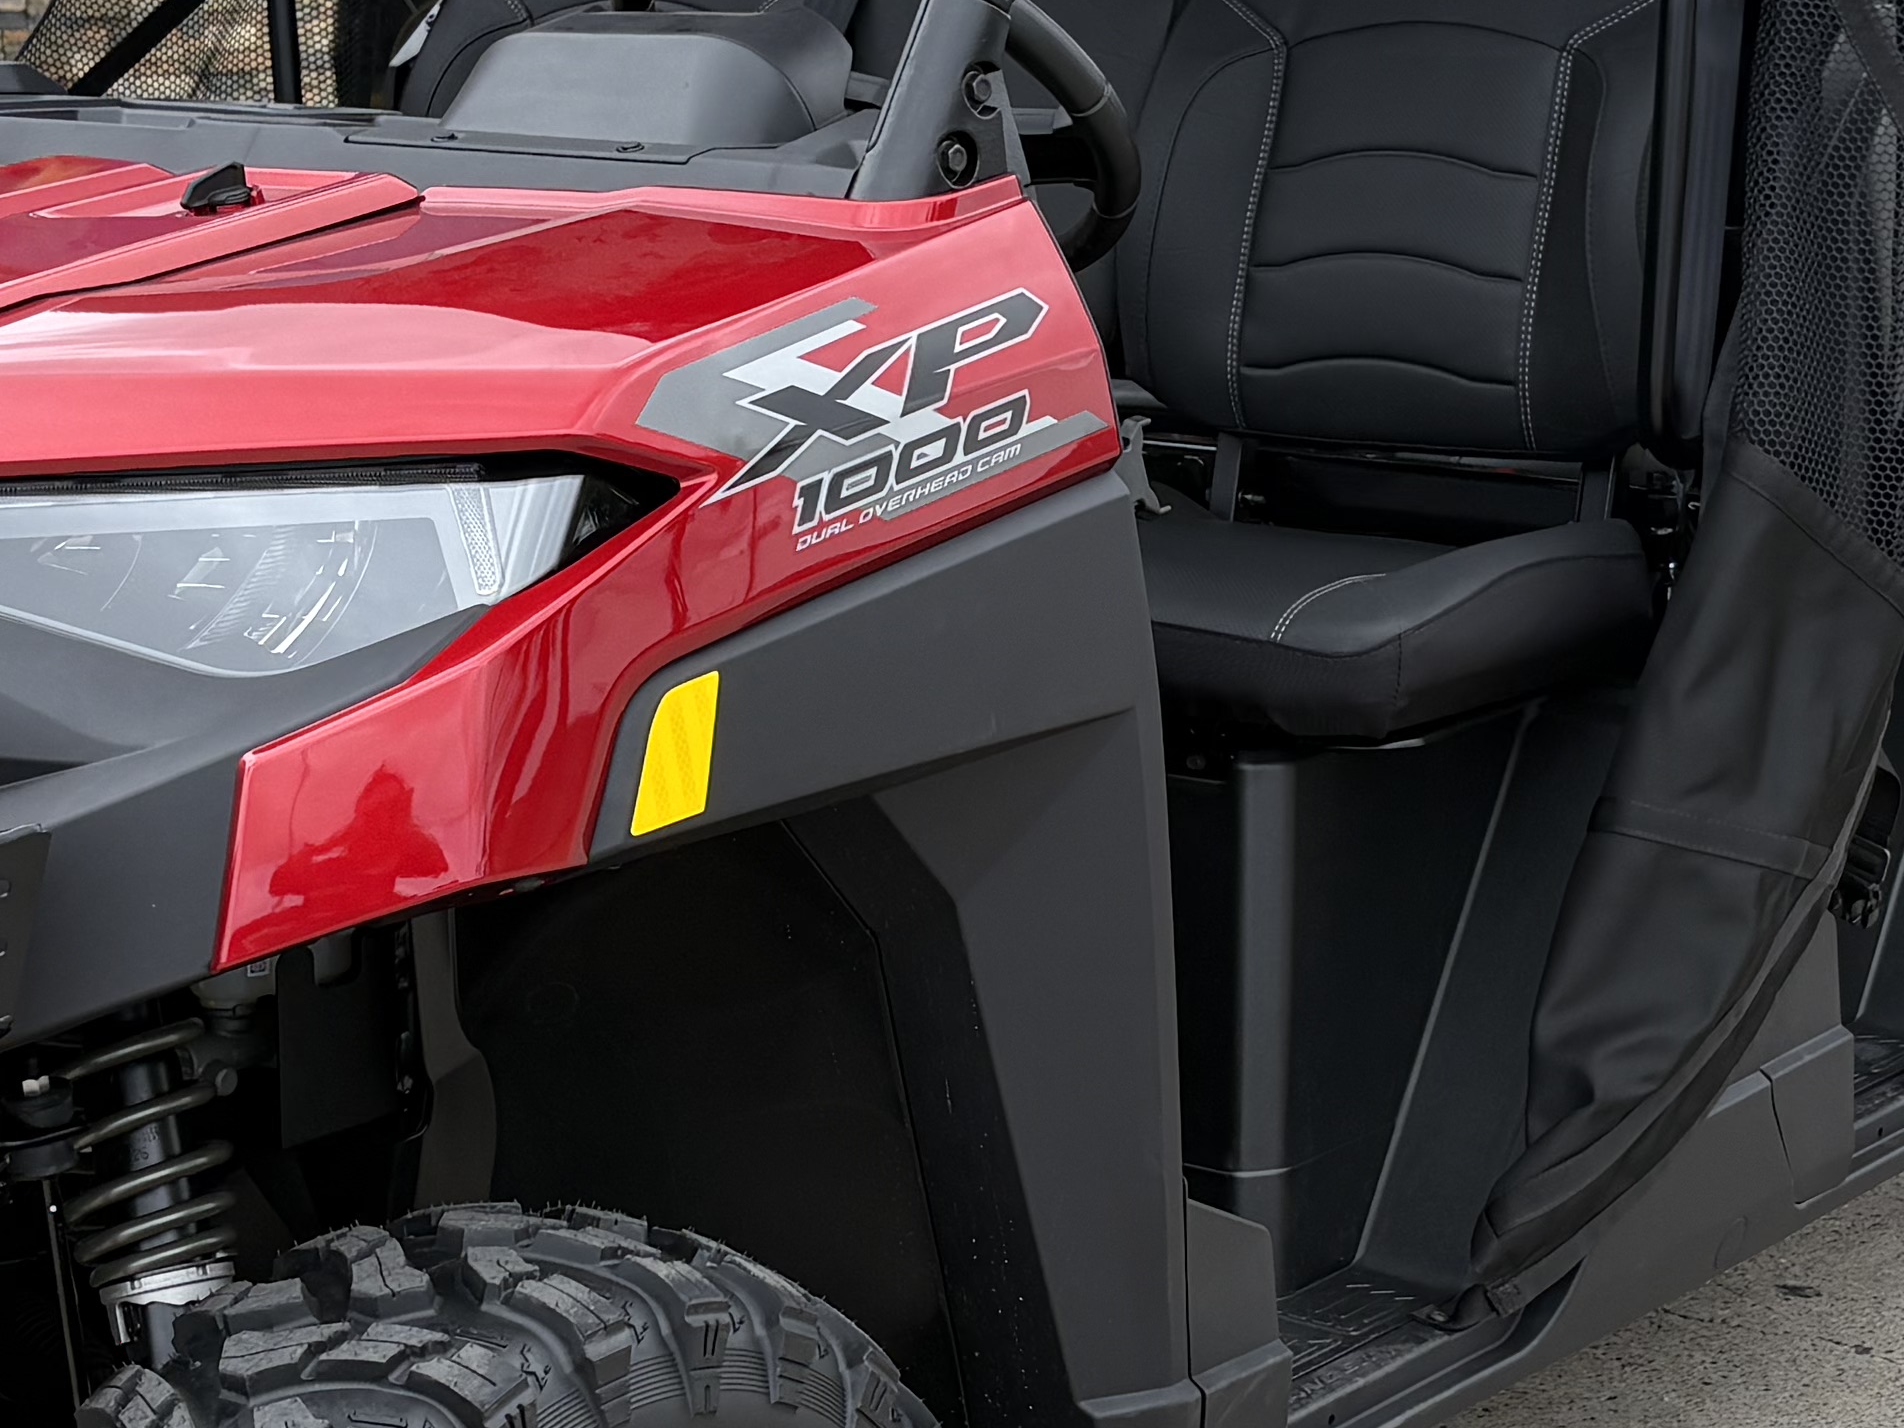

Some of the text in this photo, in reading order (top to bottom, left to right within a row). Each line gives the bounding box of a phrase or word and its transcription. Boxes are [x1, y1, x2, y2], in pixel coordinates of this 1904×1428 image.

[699, 288, 1049, 508] XP
[793, 389, 1031, 535] 1000
[796, 443, 1022, 551] DUAL OVERHEAD CAM
